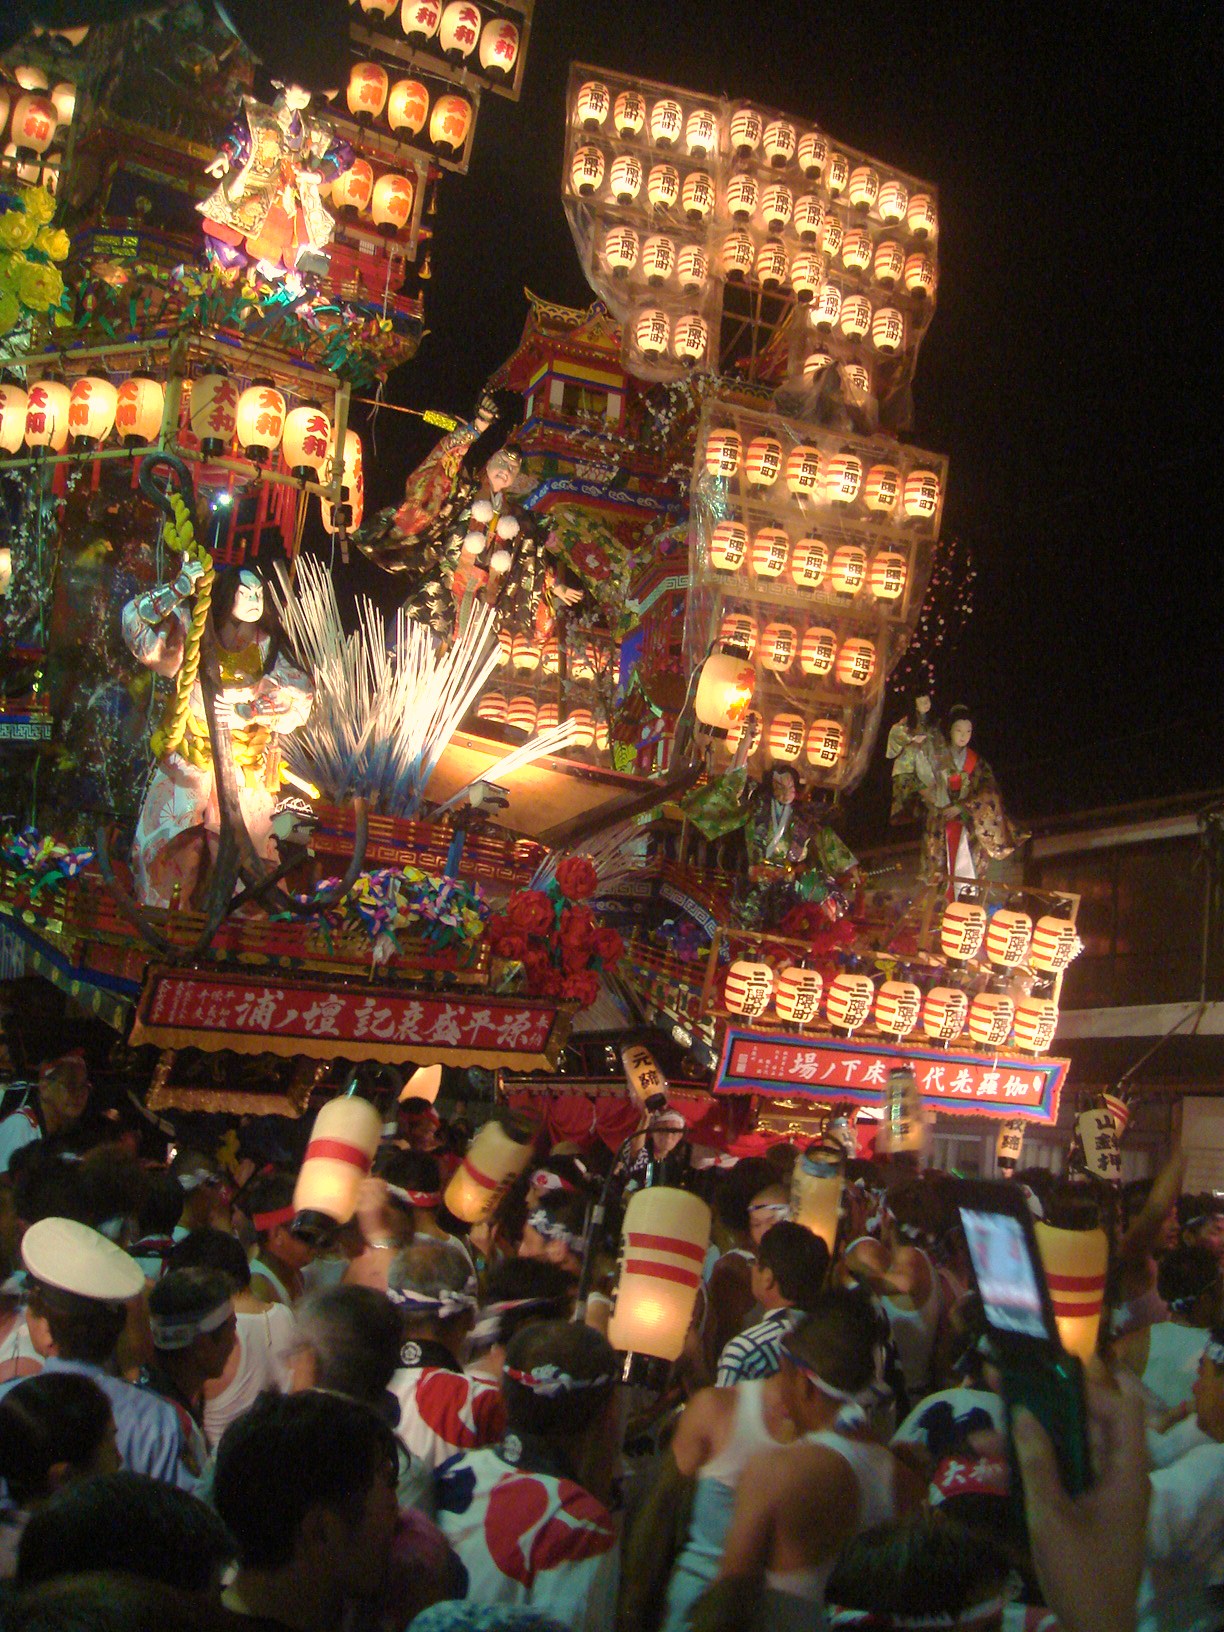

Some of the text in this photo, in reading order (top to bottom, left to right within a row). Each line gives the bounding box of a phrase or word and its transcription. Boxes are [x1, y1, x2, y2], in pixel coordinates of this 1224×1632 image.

[453, 7, 479, 46] 大和
[494, 24, 517, 62] 大和
[359, 66, 384, 105] 大和
[403, 82, 428, 122] 大和
[23, 99, 51, 141] 大和
[442, 98, 468, 138] 大和
[348, 159, 372, 202] 大和
[387, 177, 412, 219] 大和
[25, 387, 49, 434] 大和
[68, 380, 93, 427] 大和
[115, 381, 139, 428] 大和
[208, 380, 237, 432] 大和
[256, 389, 283, 438] 大和
[302, 415, 329, 459] 大和
[959, 912, 983, 955] 三隈町
[1004, 919, 1028, 962] 三隈町
[741, 971, 768, 1015] 三隈町
[792, 976, 818, 1021] 三隈町
[843, 982, 869, 1026] 三隈町
[893, 990, 917, 1032] 三隈町
[939, 994, 965, 1040] 三隈町
[987, 1001, 1012, 1043] 三隈町
[1033, 1006, 1056, 1047] 三隈町
[788, 1052, 1032, 1098] 伽羅先代床下ノ場
